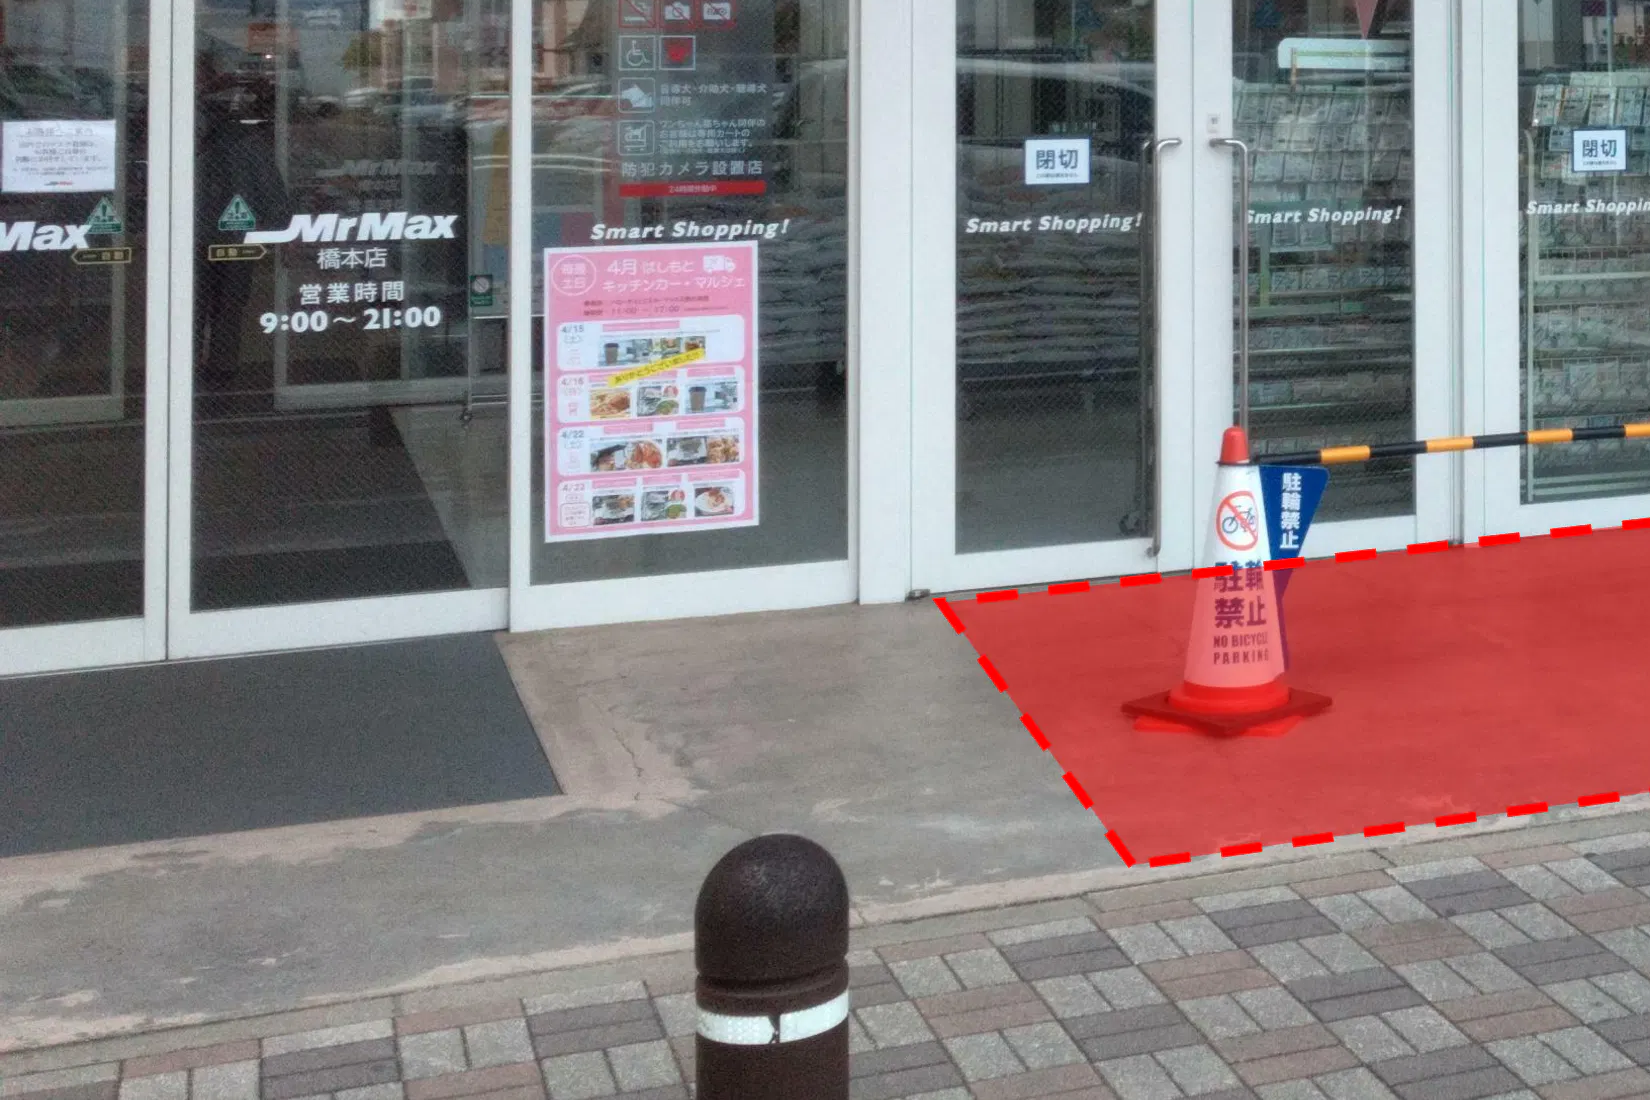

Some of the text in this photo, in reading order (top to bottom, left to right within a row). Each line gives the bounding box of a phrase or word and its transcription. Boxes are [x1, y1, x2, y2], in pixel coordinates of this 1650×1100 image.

[1582, 139, 1617, 158] 閉切
[622, 160, 763, 177] 防犯カメラ設置店
[1036, 149, 1079, 170] 閉切
[1307, 205, 1402, 225] Shopping!
[1526, 200, 1580, 215] Smart
[244, 212, 458, 244] MrMax
[591, 219, 789, 240] Smart Shopping!
[965, 212, 1143, 233] Smart Shopping!
[317, 247, 387, 270] 橋本店
[607, 259, 695, 276] 4月 はしもと
[299, 280, 405, 306] 営業時間
[602, 277, 745, 292] キッチンカー・マルシェ
[1279, 472, 1303, 550] 駐輪禁止
[1214, 595, 1267, 629] 禁止
[1213, 635, 1229, 649] NO
[1213, 649, 1269, 666] PARKING
